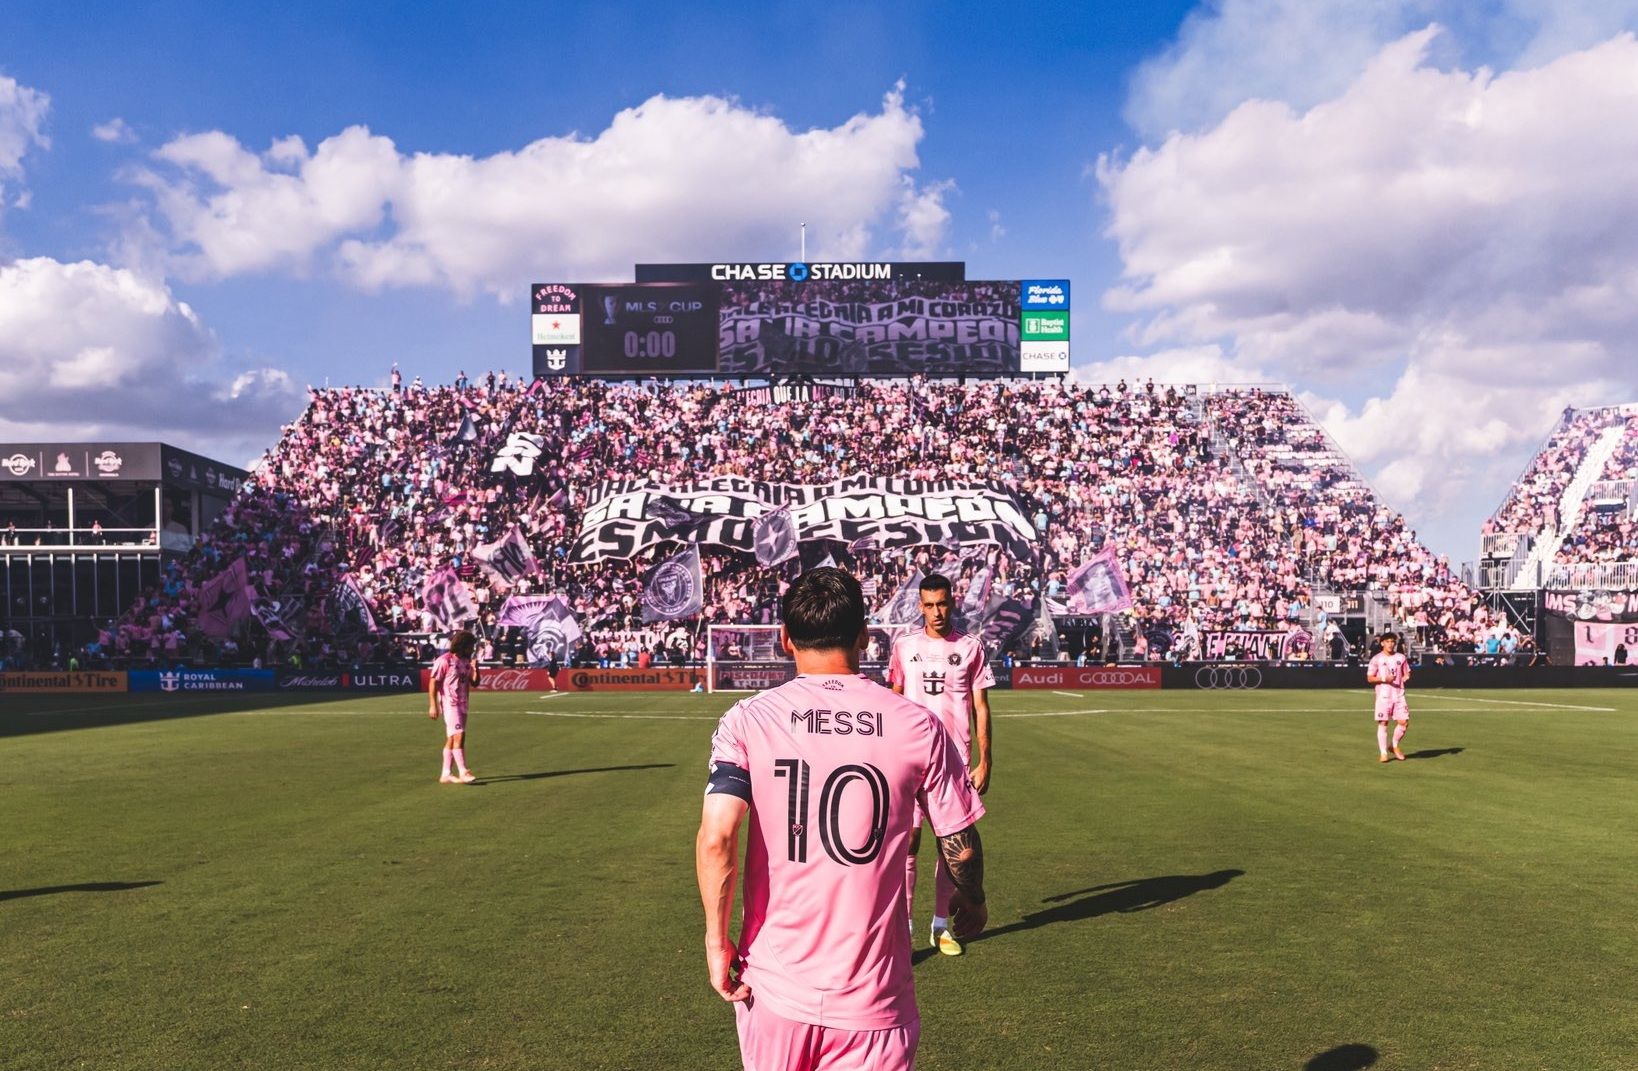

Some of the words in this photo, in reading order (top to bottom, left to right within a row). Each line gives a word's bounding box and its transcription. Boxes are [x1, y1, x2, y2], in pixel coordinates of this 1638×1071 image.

[711, 265, 786, 280] CHASE
[811, 264, 891, 279] STADIUM
[535, 285, 577, 301] FREEDOM
[625, 302, 657, 311] MLS
[670, 302, 702, 311] CUP
[897, 299, 924, 315] MI
[624, 331, 675, 357] 0:00
[1022, 352, 1056, 360] CHASE
[218, 473, 235, 491] Hard
[0, 673, 71, 688] ontinental
[83, 673, 118, 688] Tire
[354, 675, 413, 686] ULTRA
[570, 672, 661, 688] Continental
[720, 670, 787, 680] DISCOUNT
[1018, 673, 1063, 684] Audi
[791, 709, 883, 737] MESSI
[774, 758, 890, 867] 10
